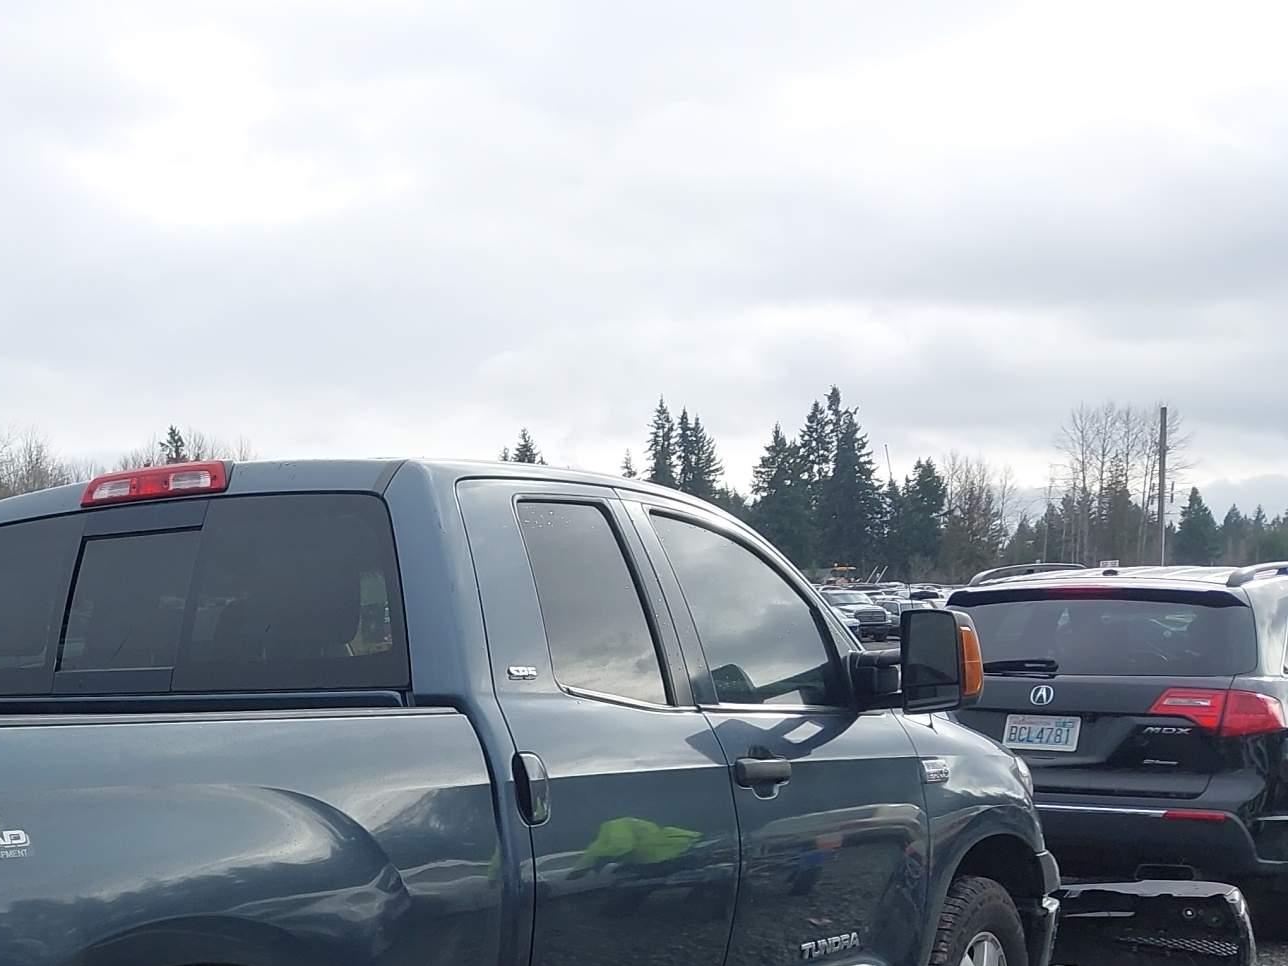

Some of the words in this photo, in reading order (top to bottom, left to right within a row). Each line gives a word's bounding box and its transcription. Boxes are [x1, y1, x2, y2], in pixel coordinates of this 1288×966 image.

[1008, 725, 1071, 745] BCL4781
[1143, 726, 1193, 736] MDX
[800, 931, 861, 960] TUNDRA
